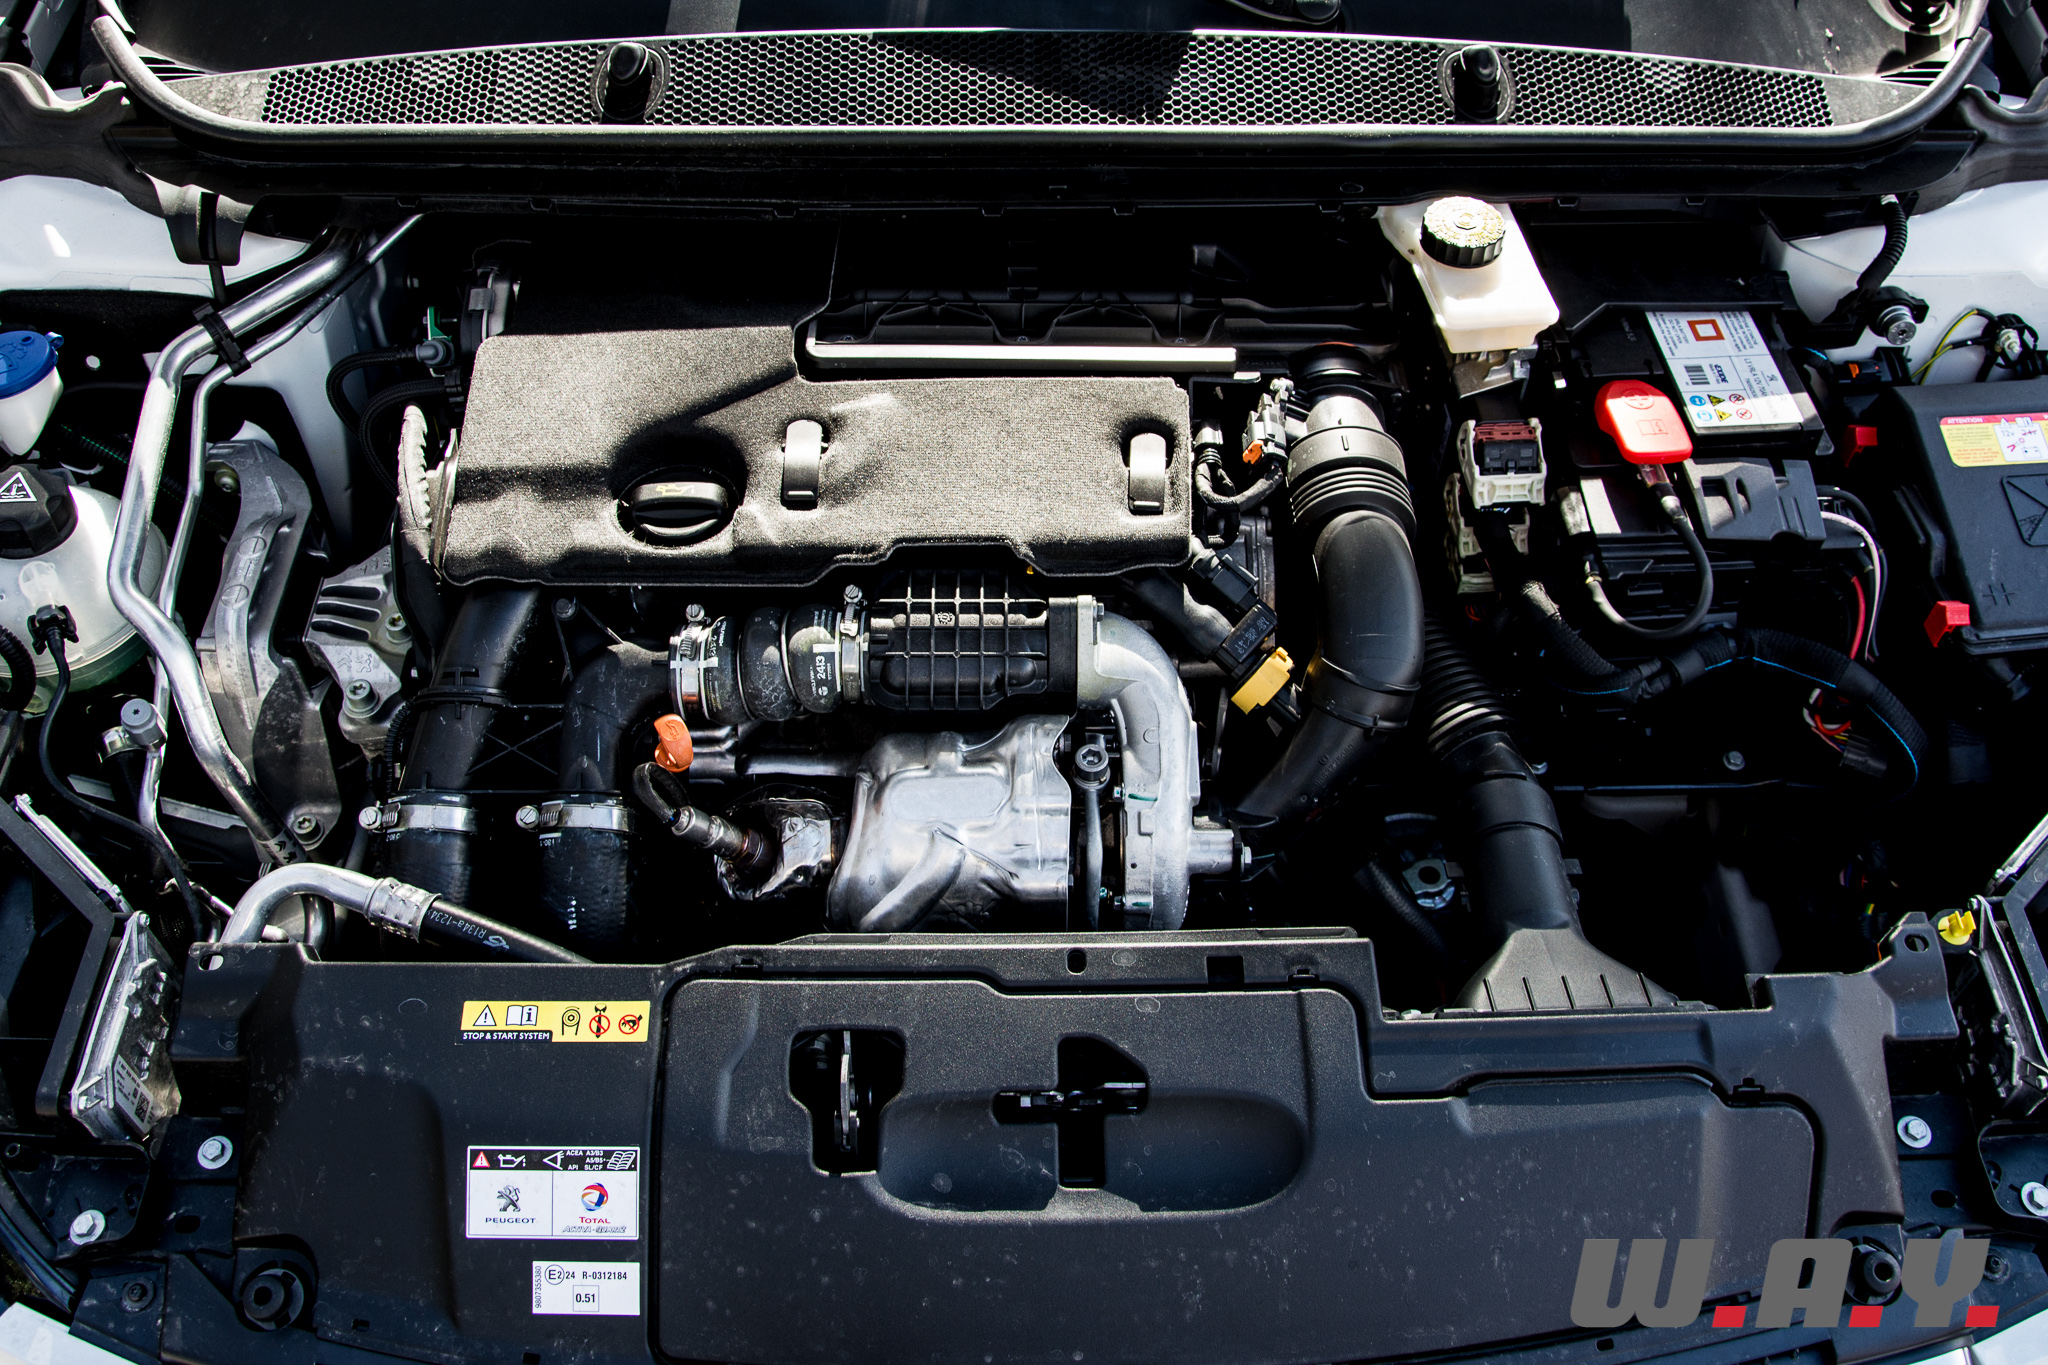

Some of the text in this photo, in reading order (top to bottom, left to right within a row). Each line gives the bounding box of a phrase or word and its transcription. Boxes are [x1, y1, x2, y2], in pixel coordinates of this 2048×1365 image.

[815, 655, 826, 680] 2413
[463, 1032, 485, 1040] STOP
[582, 1271, 628, 1280] R-0312184
[575, 1293, 596, 1304] 0.51
